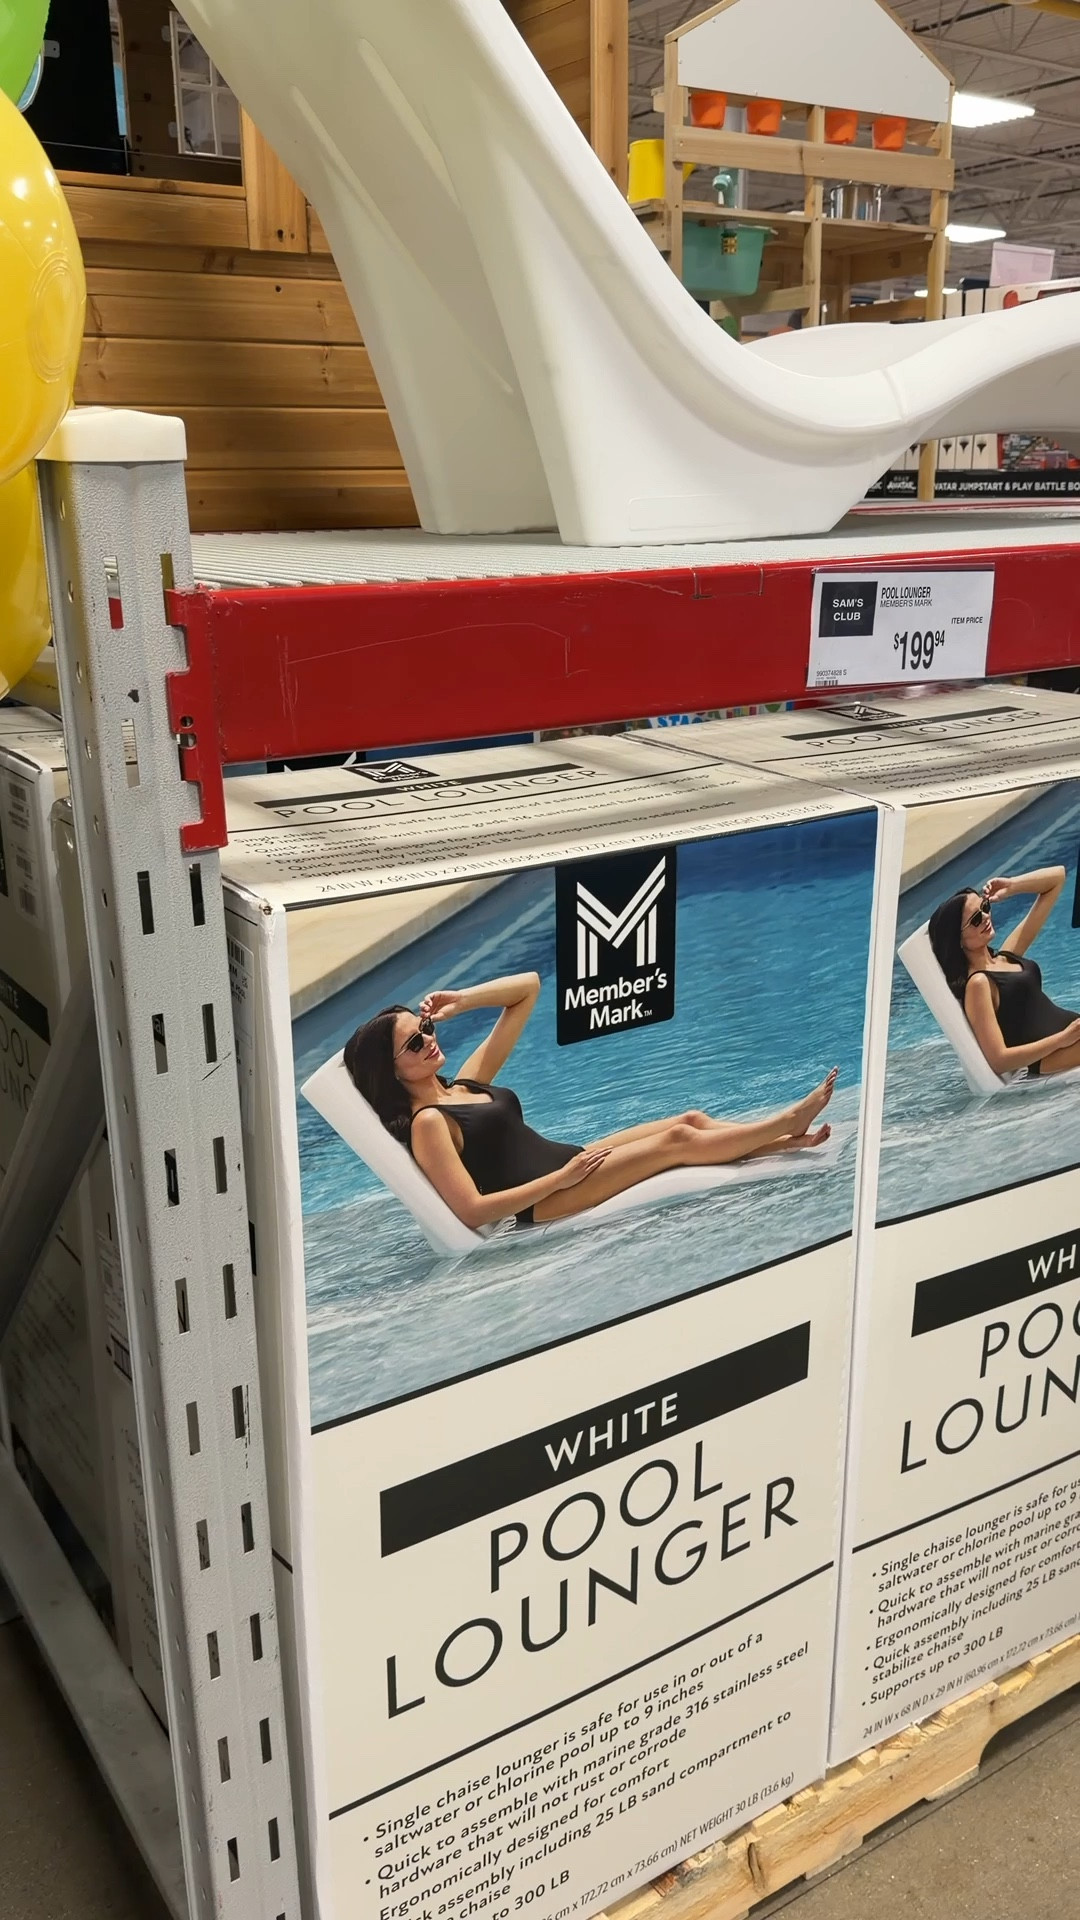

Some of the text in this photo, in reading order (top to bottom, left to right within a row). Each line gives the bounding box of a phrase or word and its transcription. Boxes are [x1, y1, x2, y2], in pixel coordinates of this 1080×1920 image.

[958, 482, 1002, 491] JUMPSTART
[1004, 482, 1010, 490] &
[1012, 482, 1033, 490] PLAY
[1034, 482, 1066, 490] BATTLE
[832, 598, 864, 608] SAM'S
[833, 611, 861, 622] CLUB
[880, 599, 932, 608] MEMBER'S MARK
[881, 586, 931, 599] POOL LOUNGER
[951, 616, 983, 625] ITEM PRICE
[901, 710, 1052, 736] LOUNGER
[273, 799, 404, 818] POOL
[411, 770, 609, 802] LOUNGER
[396, 779, 461, 792] WHITE
[565, 967, 668, 1011] Member's
[980, 1299, 1080, 1379] PO
[544, 1392, 678, 1471] WHITE
[490, 1440, 723, 1593] POOL
[878, 1491, 1077, 1593] saltwater or chlorine pool up to 9
[881, 1552, 920, 1576] Single
[923, 1534, 962, 1557] chaise
[965, 1512, 1011, 1539] lounger
[1013, 1506, 1022, 1517] is
[1026, 1492, 1049, 1511] safe
[1052, 1484, 1068, 1499] for
[386, 1476, 799, 1719] LOUNGER
[875, 1601, 962, 1649] Ergonomically
[965, 1570, 1017, 1605] designed
[1020, 1564, 1036, 1578] for
[877, 1595, 936, 1628] hardware
[940, 1580, 965, 1599] that
[968, 1566, 989, 1584] will
[992, 1558, 1012, 1574] not
[1014, 1545, 1038, 1563] rust
[1040, 1538, 1053, 1549] or
[878, 1587, 916, 1613] Quick
[920, 1582, 933, 1594] to
[936, 1553, 992, 1586] assemble
[995, 1538, 1020, 1558] with
[1023, 1520, 1061, 1545] marine
[872, 1632, 964, 1684] stabilize chaise
[873, 1643, 910, 1669] Quick
[913, 1616, 969, 1650] assembly
[971, 1588, 1023, 1621] including
[1026, 1577, 1039, 1593] 25
[1042, 1569, 1056, 1584] LB
[870, 1626, 1003, 1704] Supports up to 300 LB
[375, 1681, 703, 1858] saltwater or chlorine pool up to 9 inches
[376, 1633, 762, 1839] Single chaise lounger is safe for use in or out of a
[377, 1641, 808, 1880] Quick to assemble with marine grade 316 stainless steel
[380, 1728, 686, 1899] hardware that will not rust or corrode
[380, 1758, 669, 1920] Ergonomically designed for comfort
[438, 1712, 791, 1915] assembly including 25 LB sand compartment to
[555, 1772, 794, 1920] cm x 172.72 cm x 73.66 cm) NET WEIGHT 30 LB (13.6 kg)
[459, 1885, 511, 1919] chaise
[515, 1884, 545, 1910] 300
[551, 1870, 570, 1890] LB
